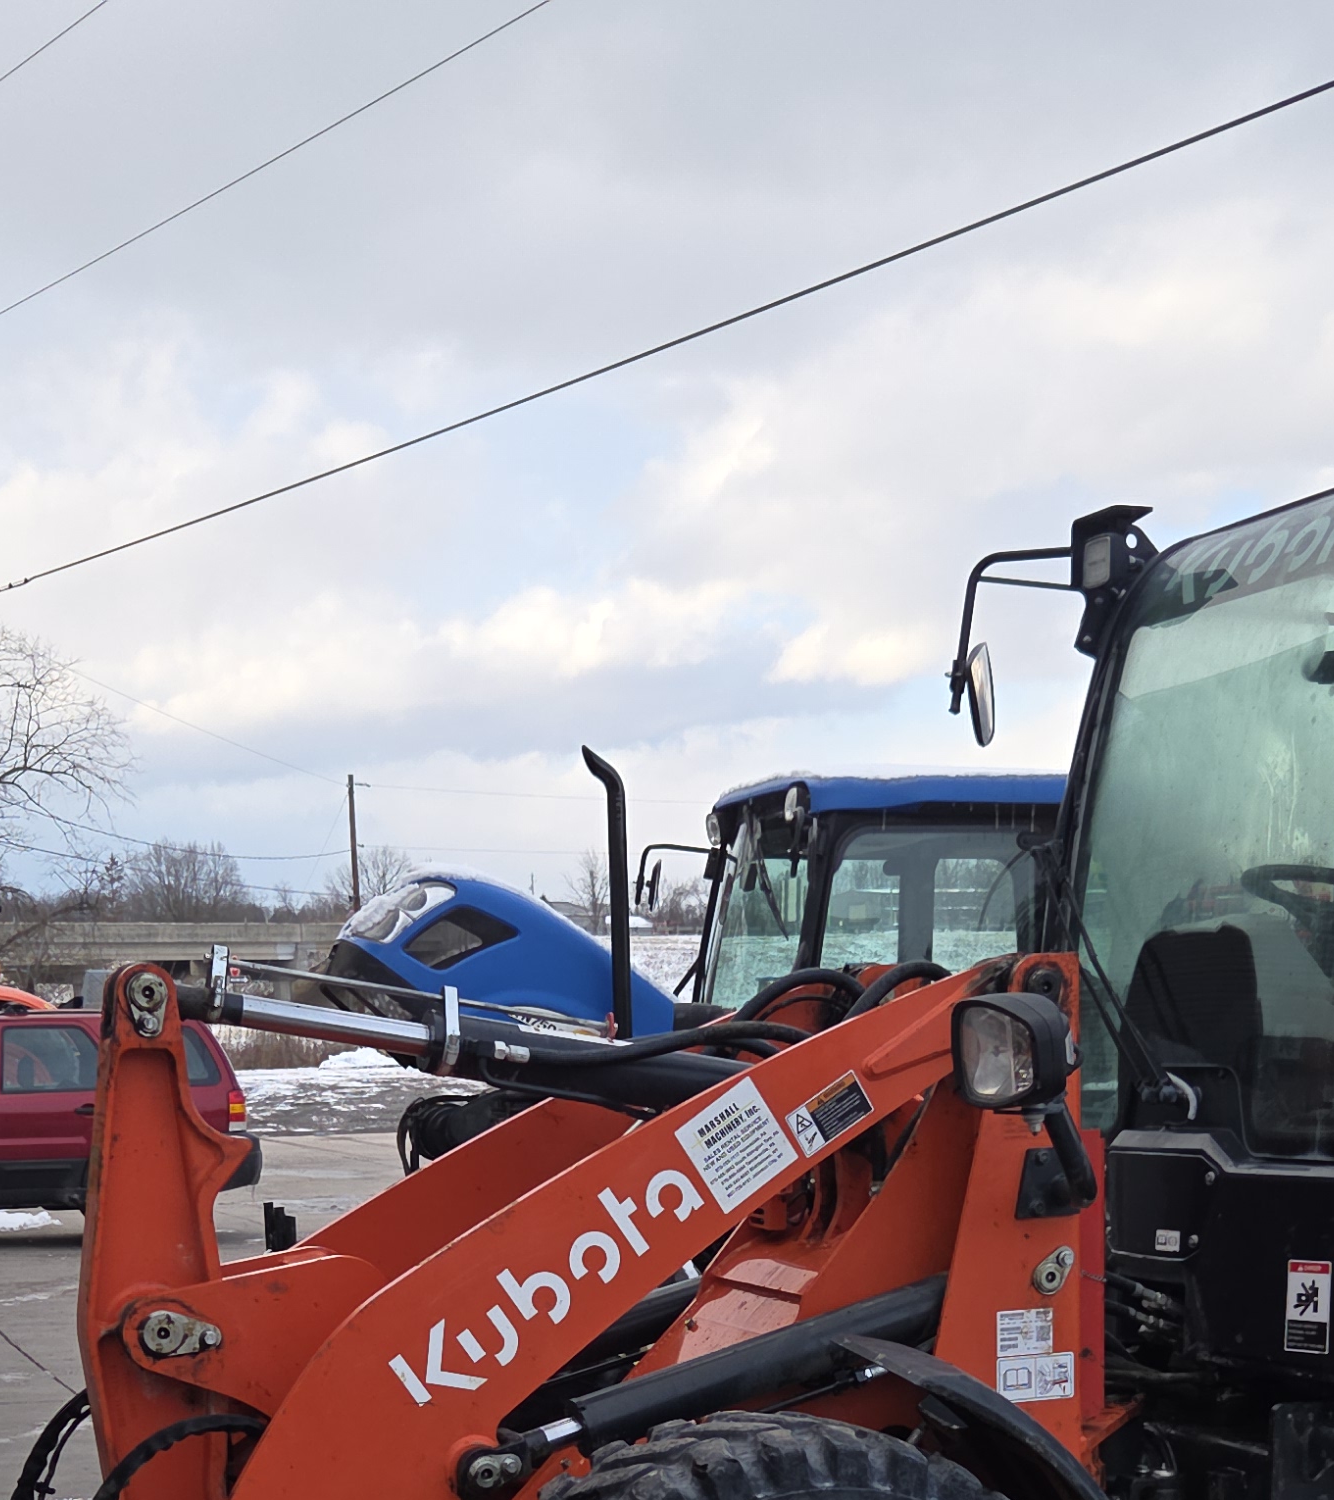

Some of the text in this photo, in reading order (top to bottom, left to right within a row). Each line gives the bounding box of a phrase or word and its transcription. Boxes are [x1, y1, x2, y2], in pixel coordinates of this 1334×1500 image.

[697, 1103, 740, 1138] MARSHALL
[703, 1148, 721, 1163] SALES
[720, 1133, 740, 1150] RENTAL
[740, 1116, 762, 1135] SERVICE
[703, 1161, 715, 1172] NEW
[715, 1152, 727, 1162] AND
[726, 1140, 741, 1153] USED
[388, 1169, 705, 1406] Kubota
